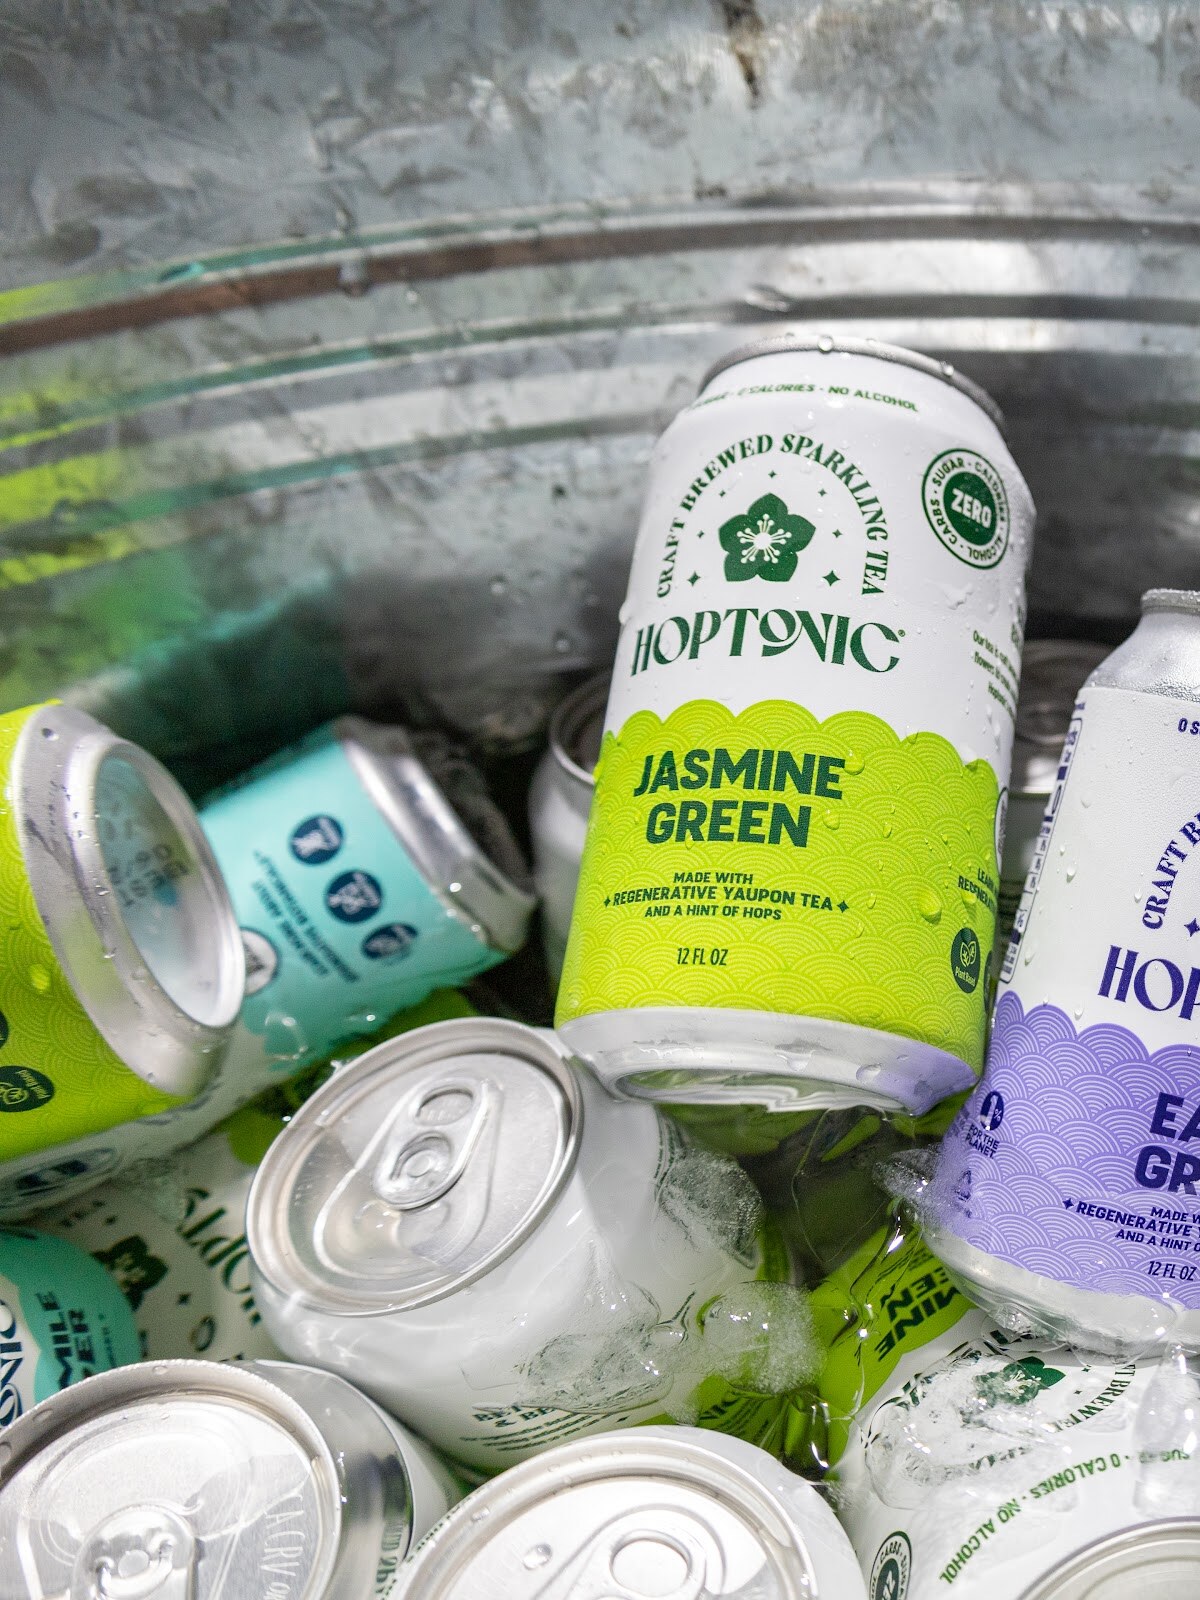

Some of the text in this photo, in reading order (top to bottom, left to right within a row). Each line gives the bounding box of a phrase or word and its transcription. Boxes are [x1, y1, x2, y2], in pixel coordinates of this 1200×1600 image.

[828, 386, 849, 396] NO
[854, 389, 919, 413] ALCOHOL
[932, 457, 965, 487] SUGAR
[656, 433, 890, 600] CRAFT BREWED SPARKLING TEA
[930, 498, 958, 545] CARBS
[950, 487, 993, 530] ZERO
[630, 608, 901, 678] HOPTONIC
[1177, 717, 1187, 732] 0
[633, 748, 846, 800] JASMINE
[645, 800, 812, 848] GREEN
[673, 871, 754, 886] MADE WITH
[1141, 840, 1188, 930] CRAFT
[613, 885, 833, 912] REGENERATIVE YAUPON TEA
[644, 904, 782, 921] AND A HINT OF HOPS
[676, 947, 729, 966] 12 FL OZ
[968, 1122, 983, 1139] FOR
[983, 1134, 1000, 1150] THE
[1076, 1200, 1193, 1238] REGENERATIVE
[1150, 1206, 1190, 1222] MADE
[1115, 1229, 1143, 1245] AND
[1145, 1236, 1157, 1246] A
[1159, 1236, 1193, 1253] HINT
[1148, 1259, 1198, 1281] 12 FL OZ
[1109, 1453, 1122, 1469] 0
[1031, 1454, 1108, 1501] CALORIES
[998, 1501, 1022, 1525] NO
[258, 1530, 306, 1577] CRV
[938, 1526, 995, 1585] ALCOHOL
